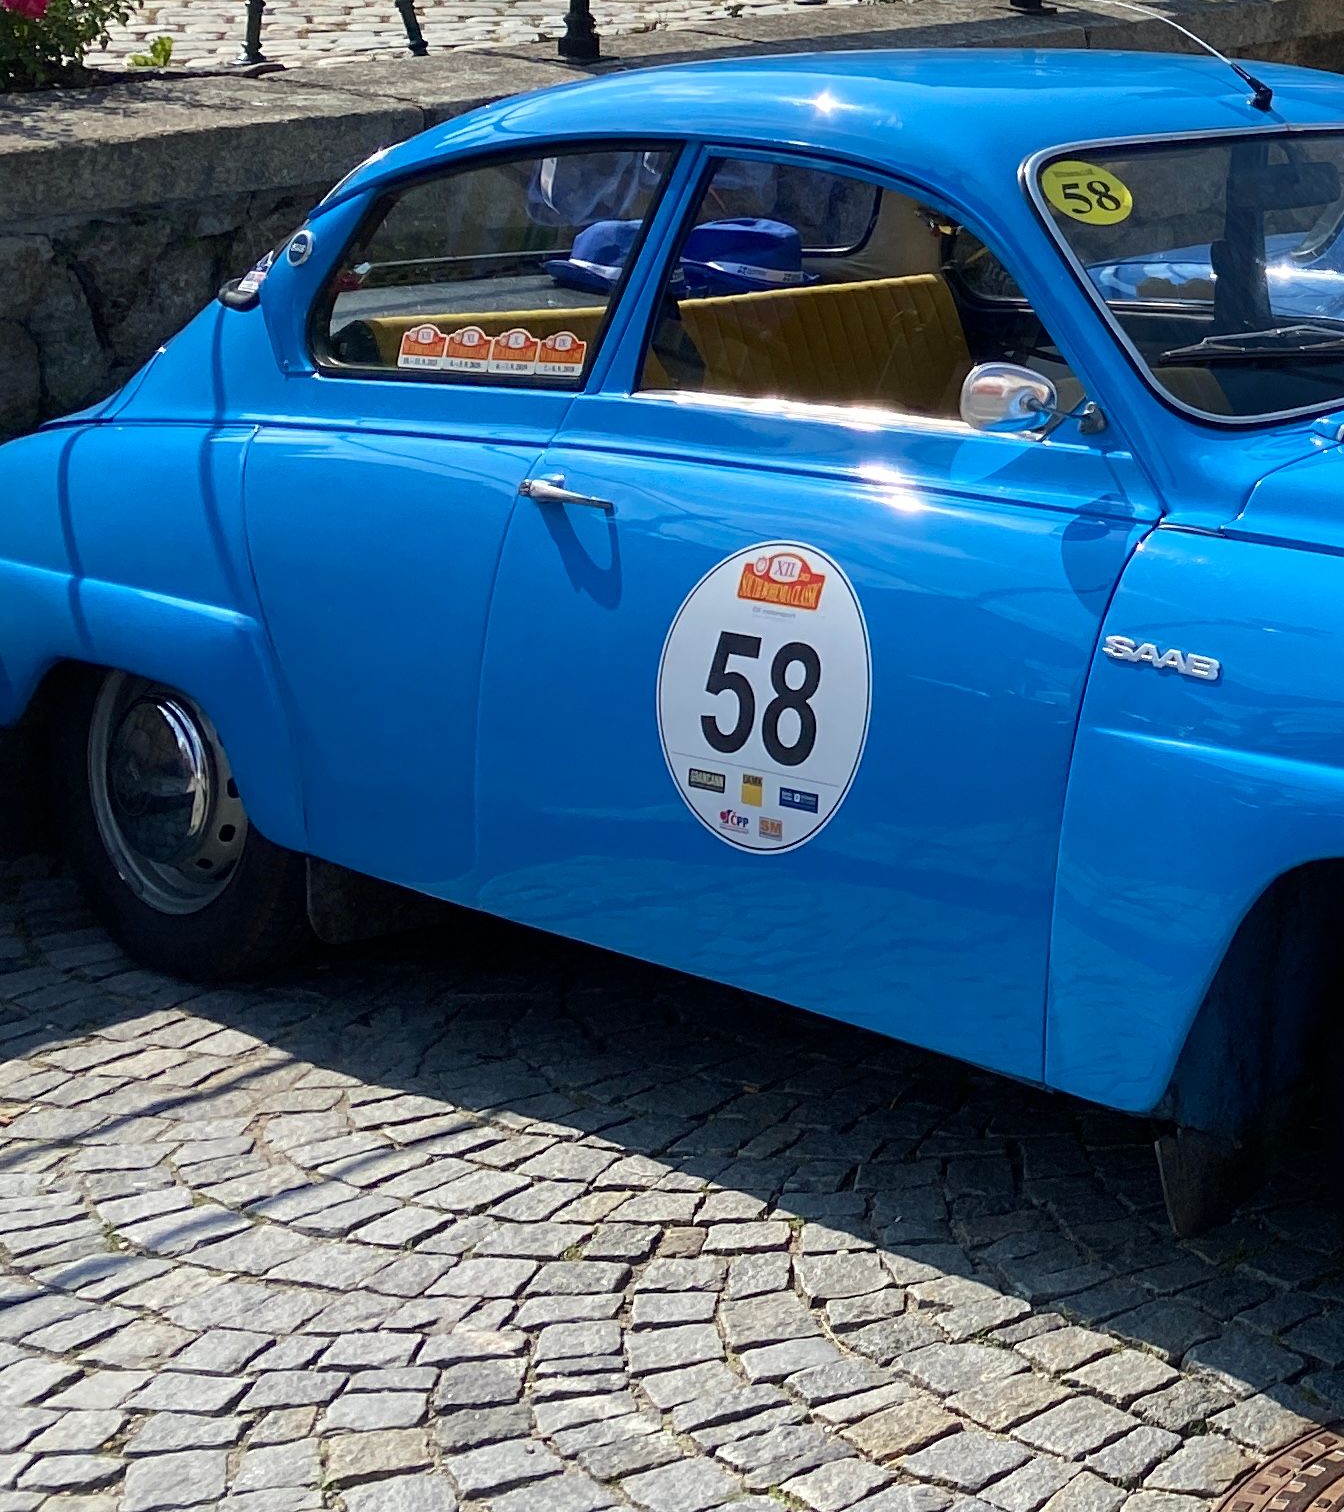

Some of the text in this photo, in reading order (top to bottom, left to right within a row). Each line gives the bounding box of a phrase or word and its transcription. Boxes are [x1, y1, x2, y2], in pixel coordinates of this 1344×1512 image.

[1062, 180, 1121, 214] 58
[1102, 635, 1220, 681] SAAB
[700, 630, 821, 766] 58
